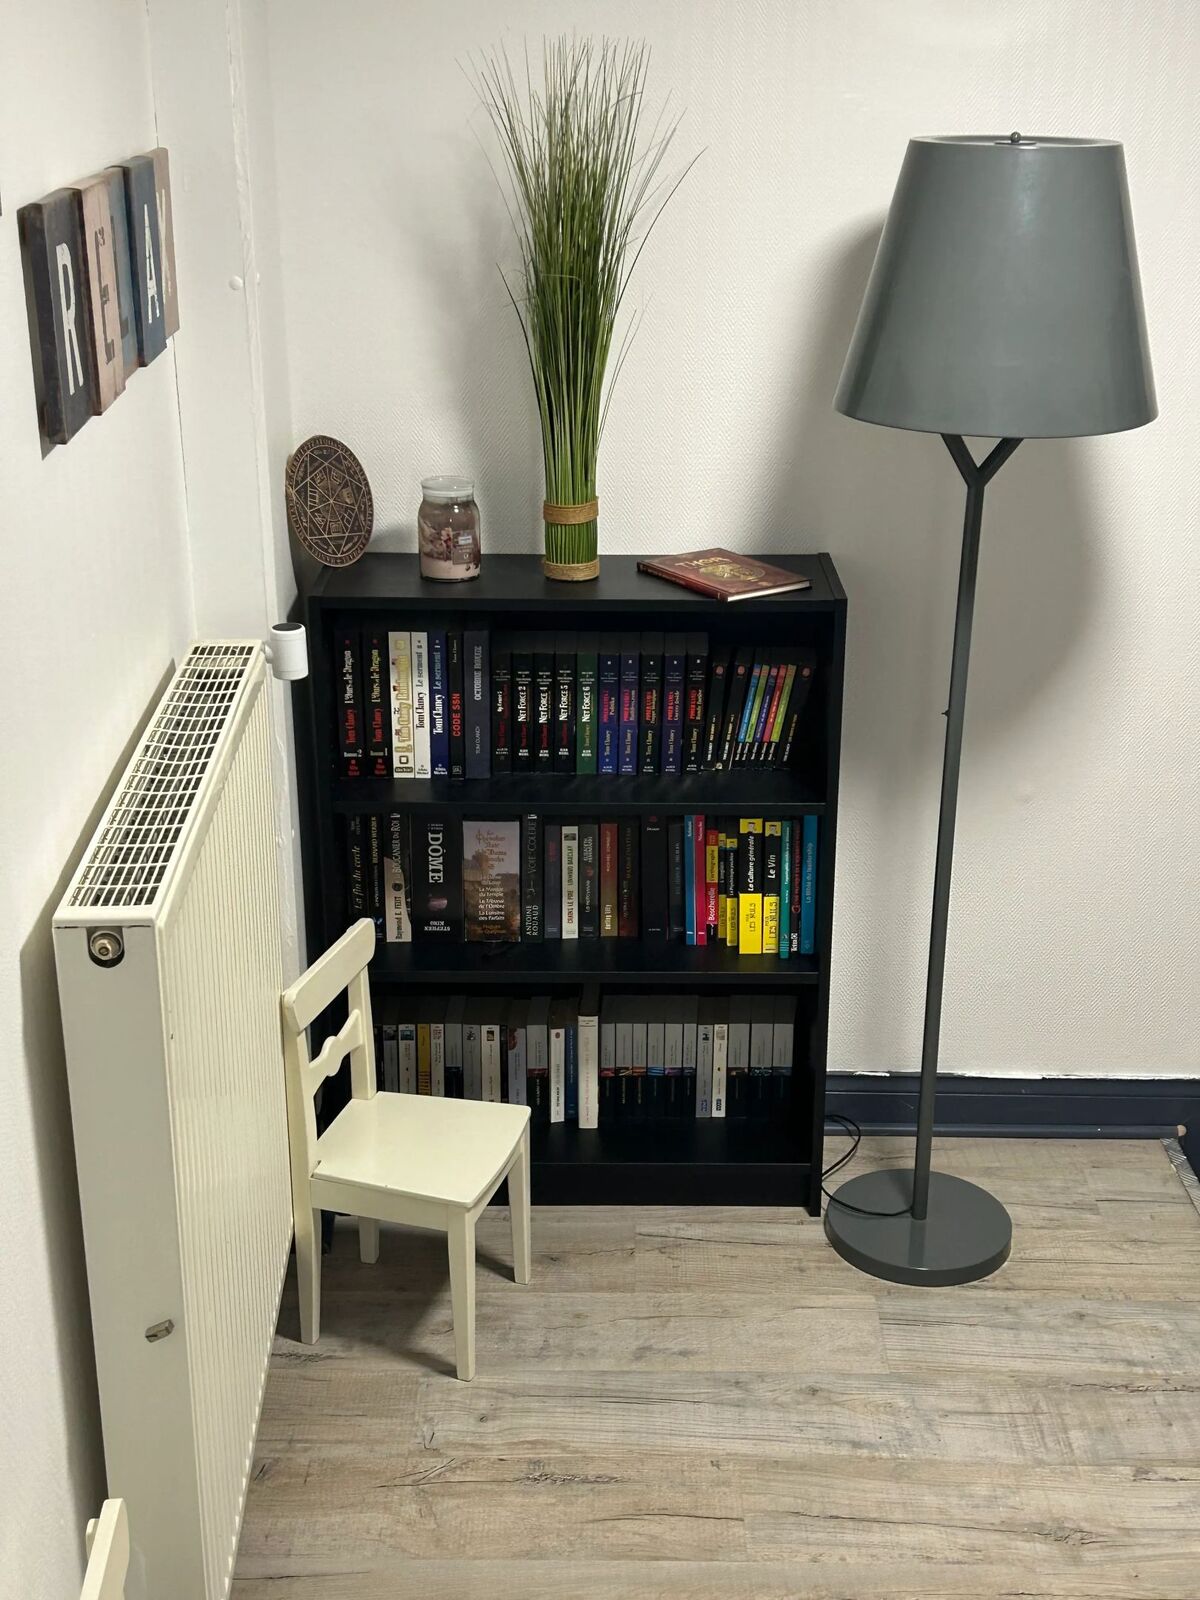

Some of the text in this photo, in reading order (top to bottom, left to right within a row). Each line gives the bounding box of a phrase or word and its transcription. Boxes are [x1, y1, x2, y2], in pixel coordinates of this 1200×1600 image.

[416, 651, 424, 678] serment
[474, 646, 482, 701] OCTOBRE ROUGE
[416, 678, 424, 688] Le
[433, 651, 445, 735] Tom Clancy Le serment
[415, 692, 427, 715] Clancy
[453, 693, 461, 737] CODE SSN
[416, 714, 425, 730] Tom
[428, 831, 447, 884] DÔME
[748, 835, 756, 862] générale
[352, 846, 364, 909] La fin du cercle
[768, 854, 776, 879] Le Vin
[395, 917, 404, 939] Raymond
[769, 901, 778, 939] LES NULS
